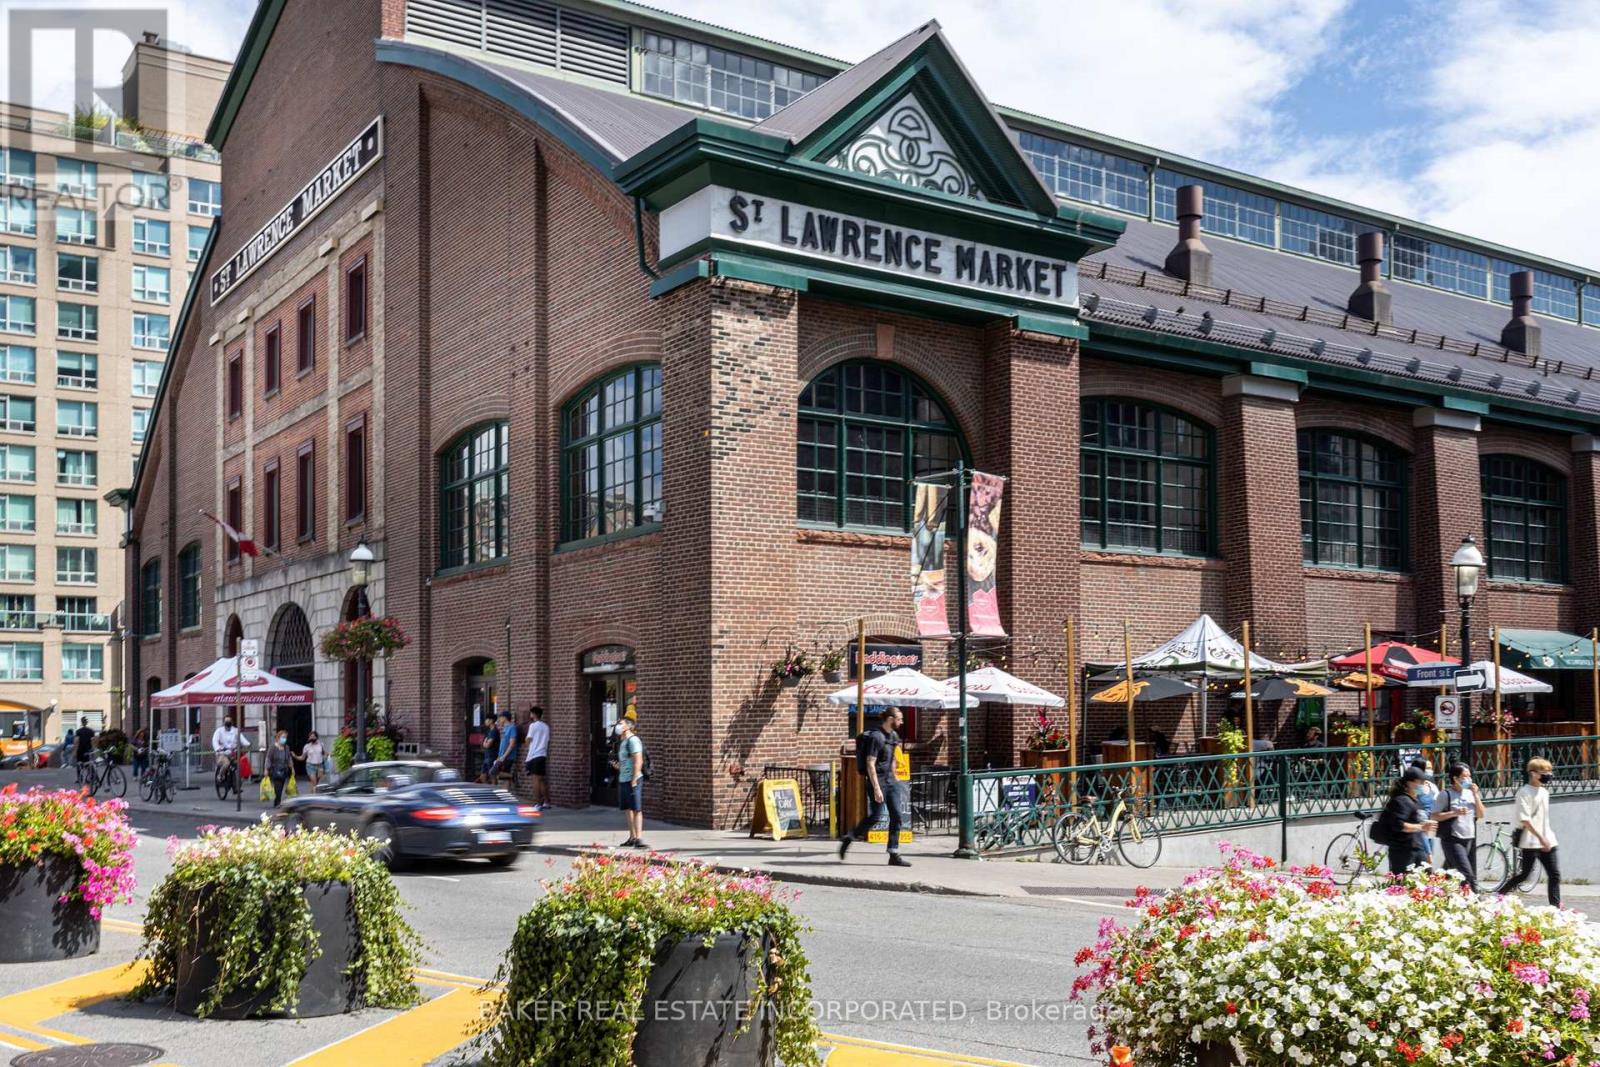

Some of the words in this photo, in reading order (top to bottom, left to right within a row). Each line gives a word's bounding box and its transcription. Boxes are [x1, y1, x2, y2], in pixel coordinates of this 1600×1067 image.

[235, 204, 294, 277] LAWRENCE
[301, 139, 362, 219] MARKET
[781, 204, 942, 275] LAWRENCE
[956, 244, 1067, 298] MARKET
[855, 651, 919, 667] addington's
[1416, 669, 1437, 678] Front
[863, 684, 921, 696] Coors
